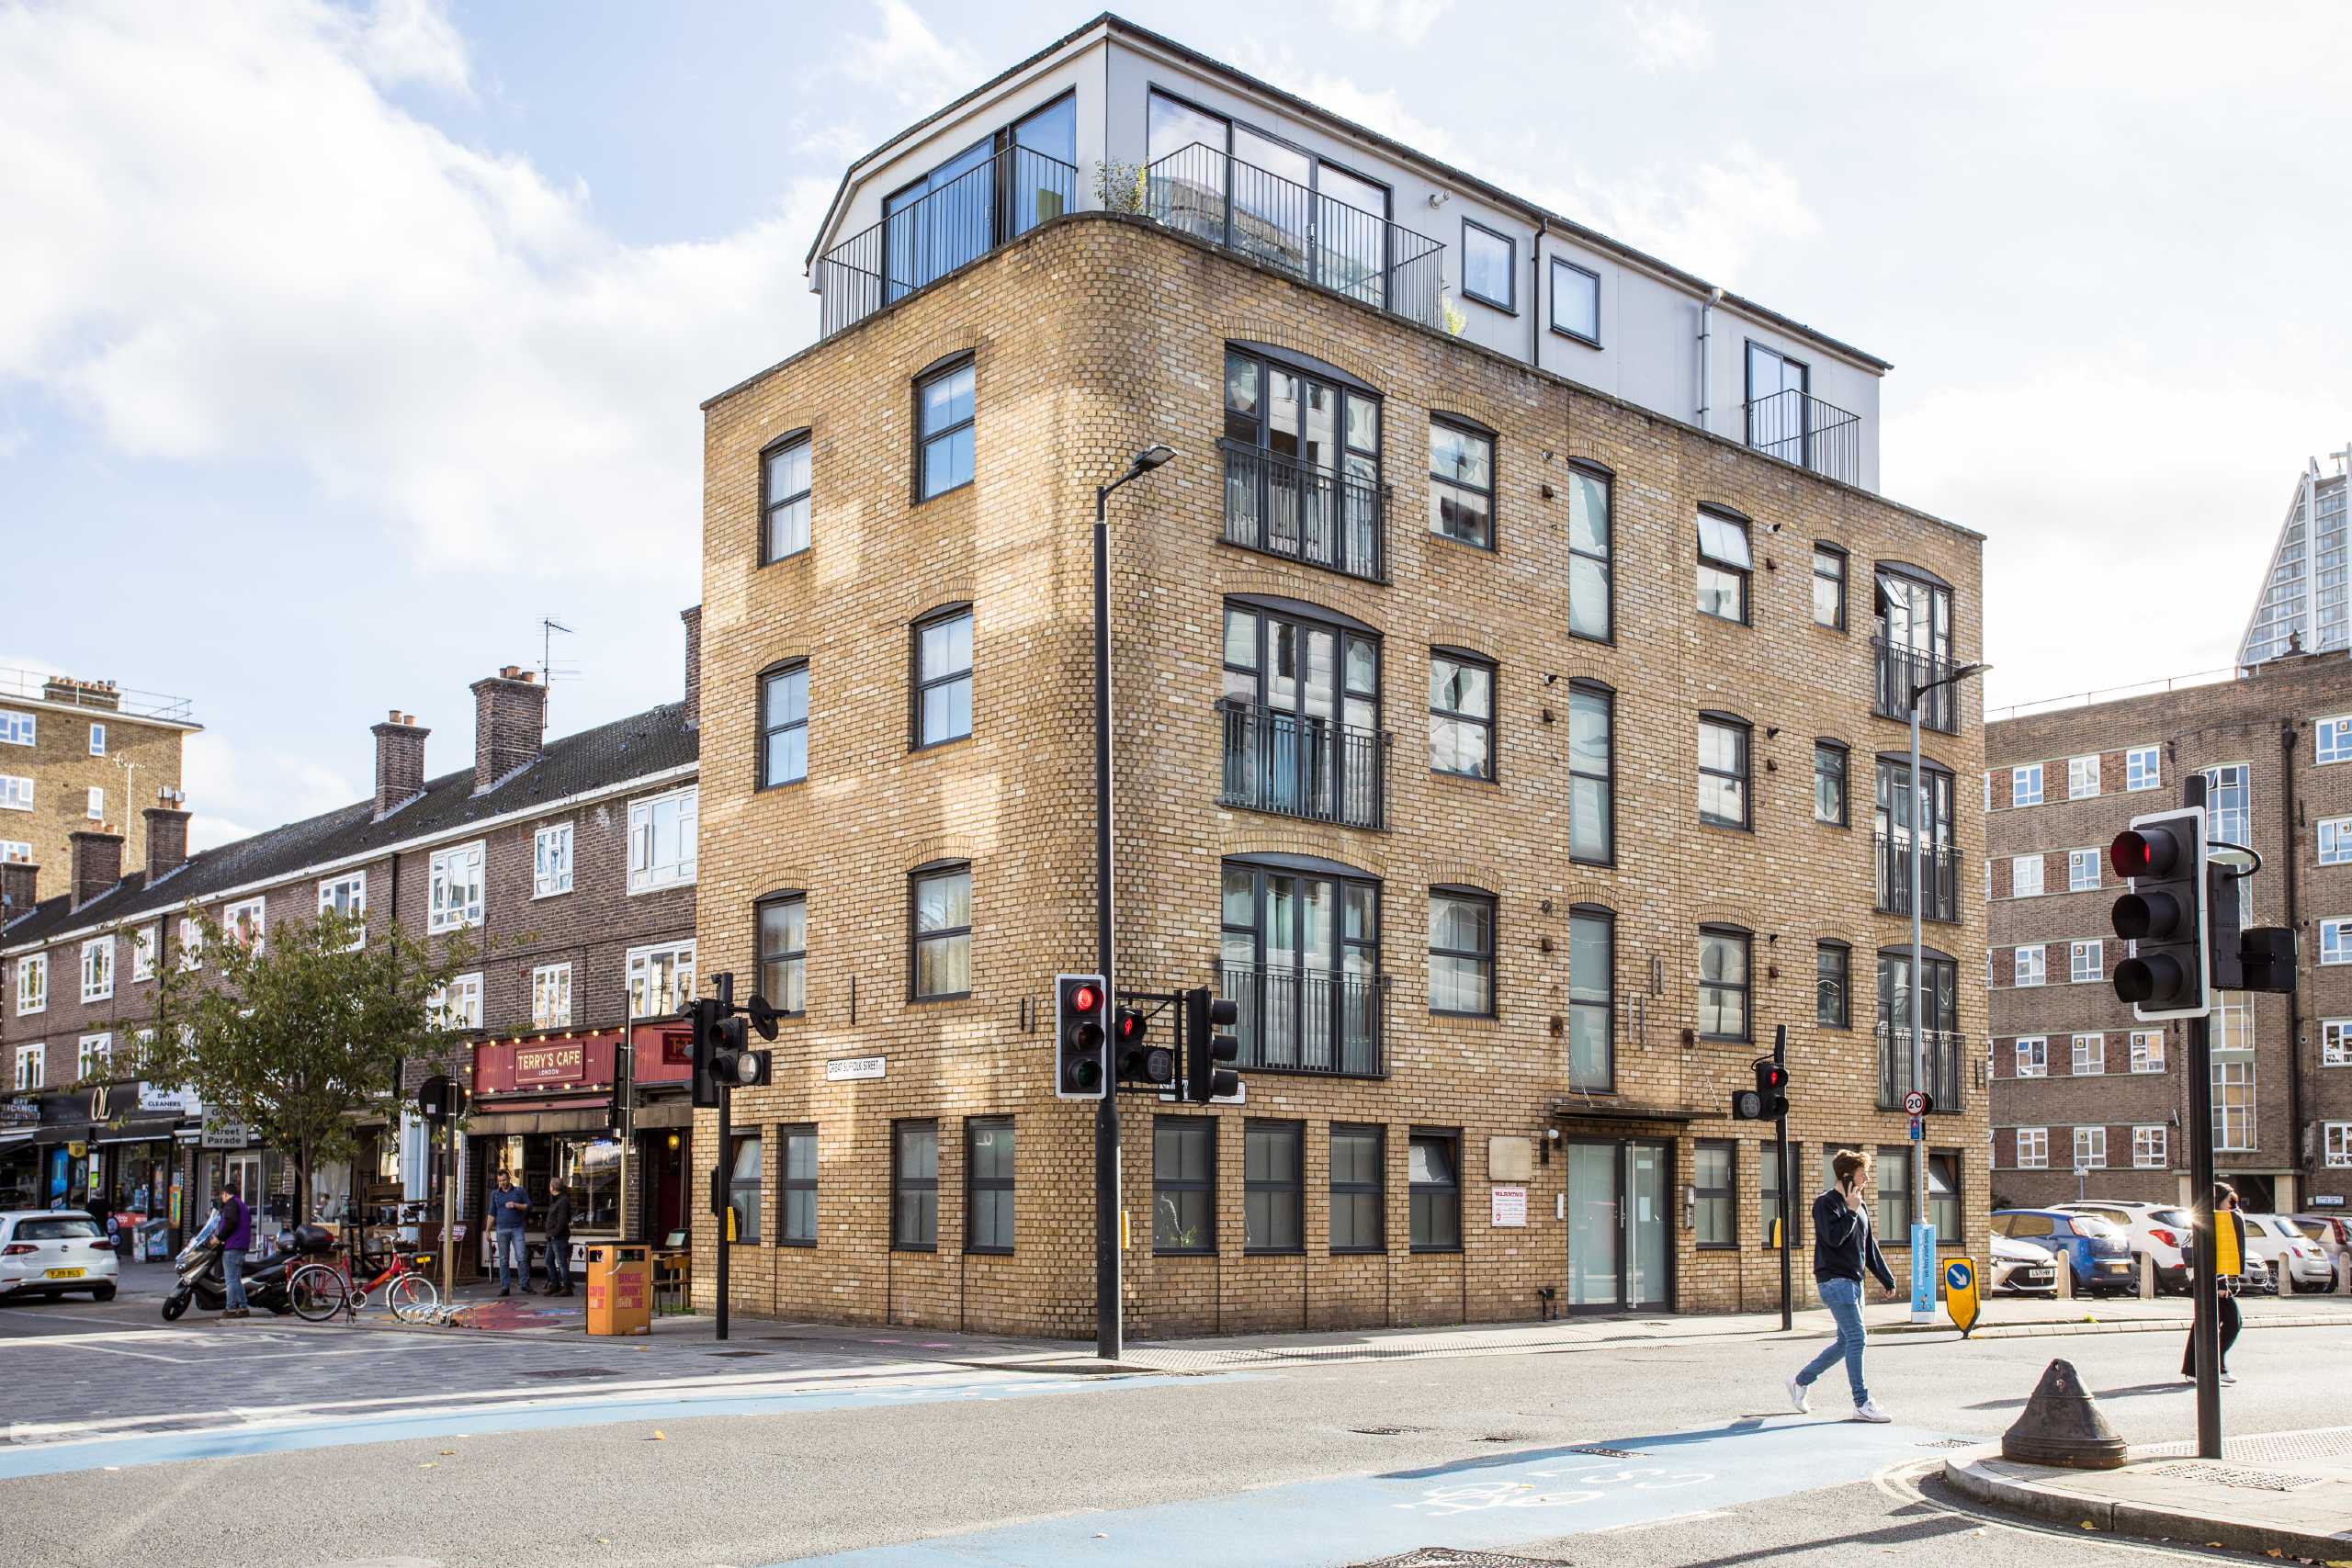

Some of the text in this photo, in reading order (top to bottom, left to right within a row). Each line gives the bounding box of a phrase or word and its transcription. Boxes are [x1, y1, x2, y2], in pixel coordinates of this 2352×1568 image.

[517, 1050, 581, 1071] TERRY'S CAFE
[829, 1062, 842, 1073] GREAT
[843, 1060, 863, 1072] SUFFOLK
[864, 1059, 878, 1071] STREET
[538, 1068, 560, 1077] LONDON
[1907, 1098, 1922, 1109] 20
[207, 1136, 242, 1145] Parade
